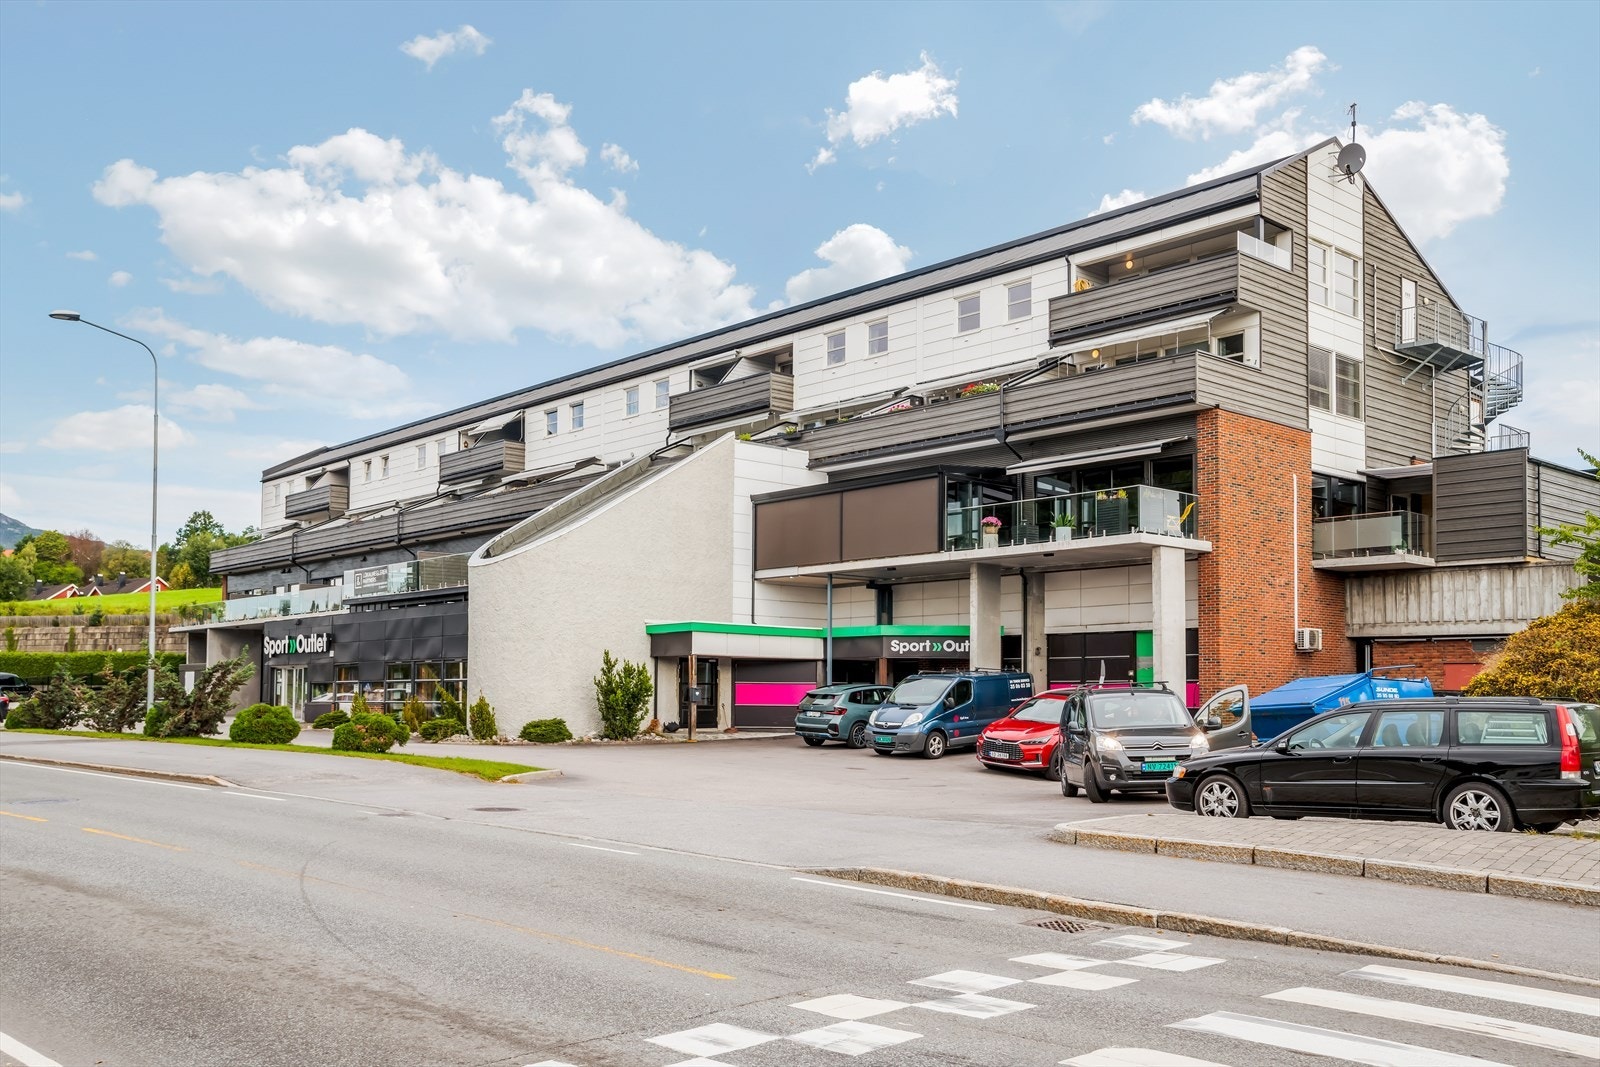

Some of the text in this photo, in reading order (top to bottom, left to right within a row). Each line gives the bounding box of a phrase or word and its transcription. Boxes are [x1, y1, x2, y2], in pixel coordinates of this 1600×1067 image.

[264, 633, 327, 658] Sport Outlet
[890, 640, 970, 654] Sport Out
